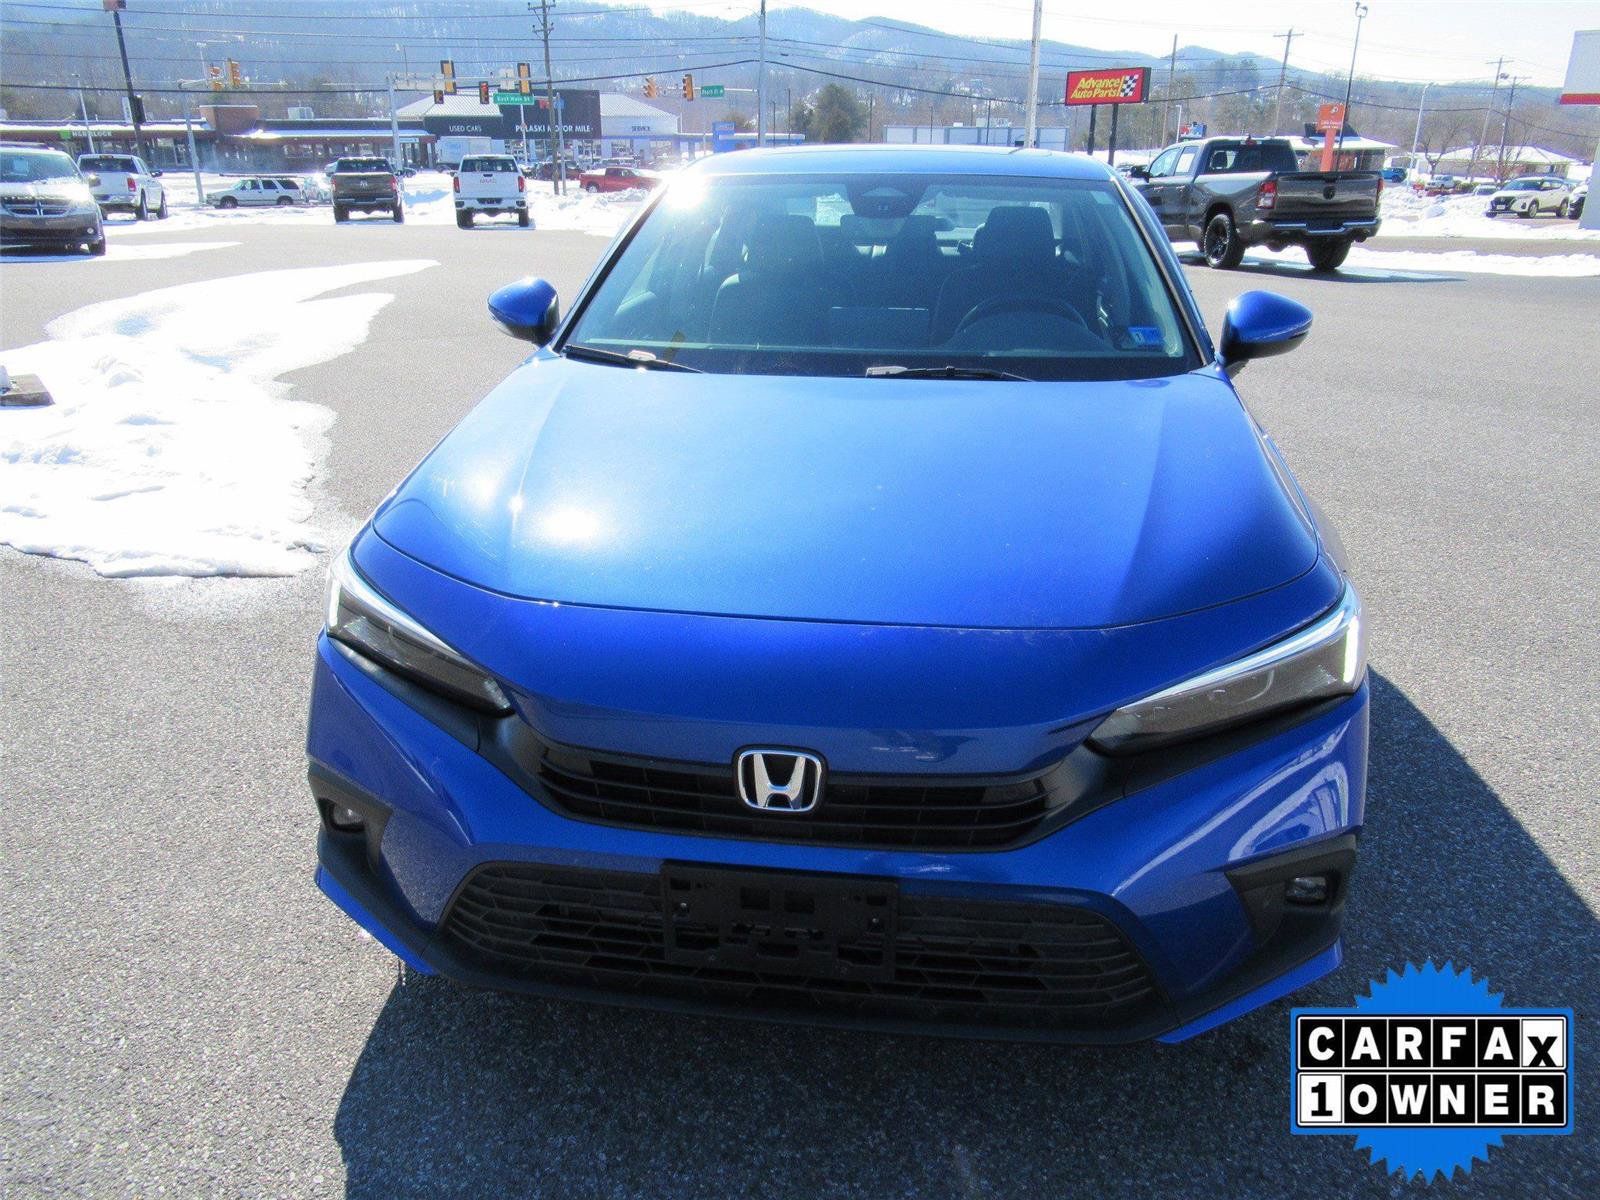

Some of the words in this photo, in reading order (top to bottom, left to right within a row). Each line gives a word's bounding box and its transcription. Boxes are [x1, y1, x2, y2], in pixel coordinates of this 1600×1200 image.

[1079, 77, 1120, 88] Advance
[1071, 89, 1093, 98] Auto
[1093, 88, 1117, 97] Parts
